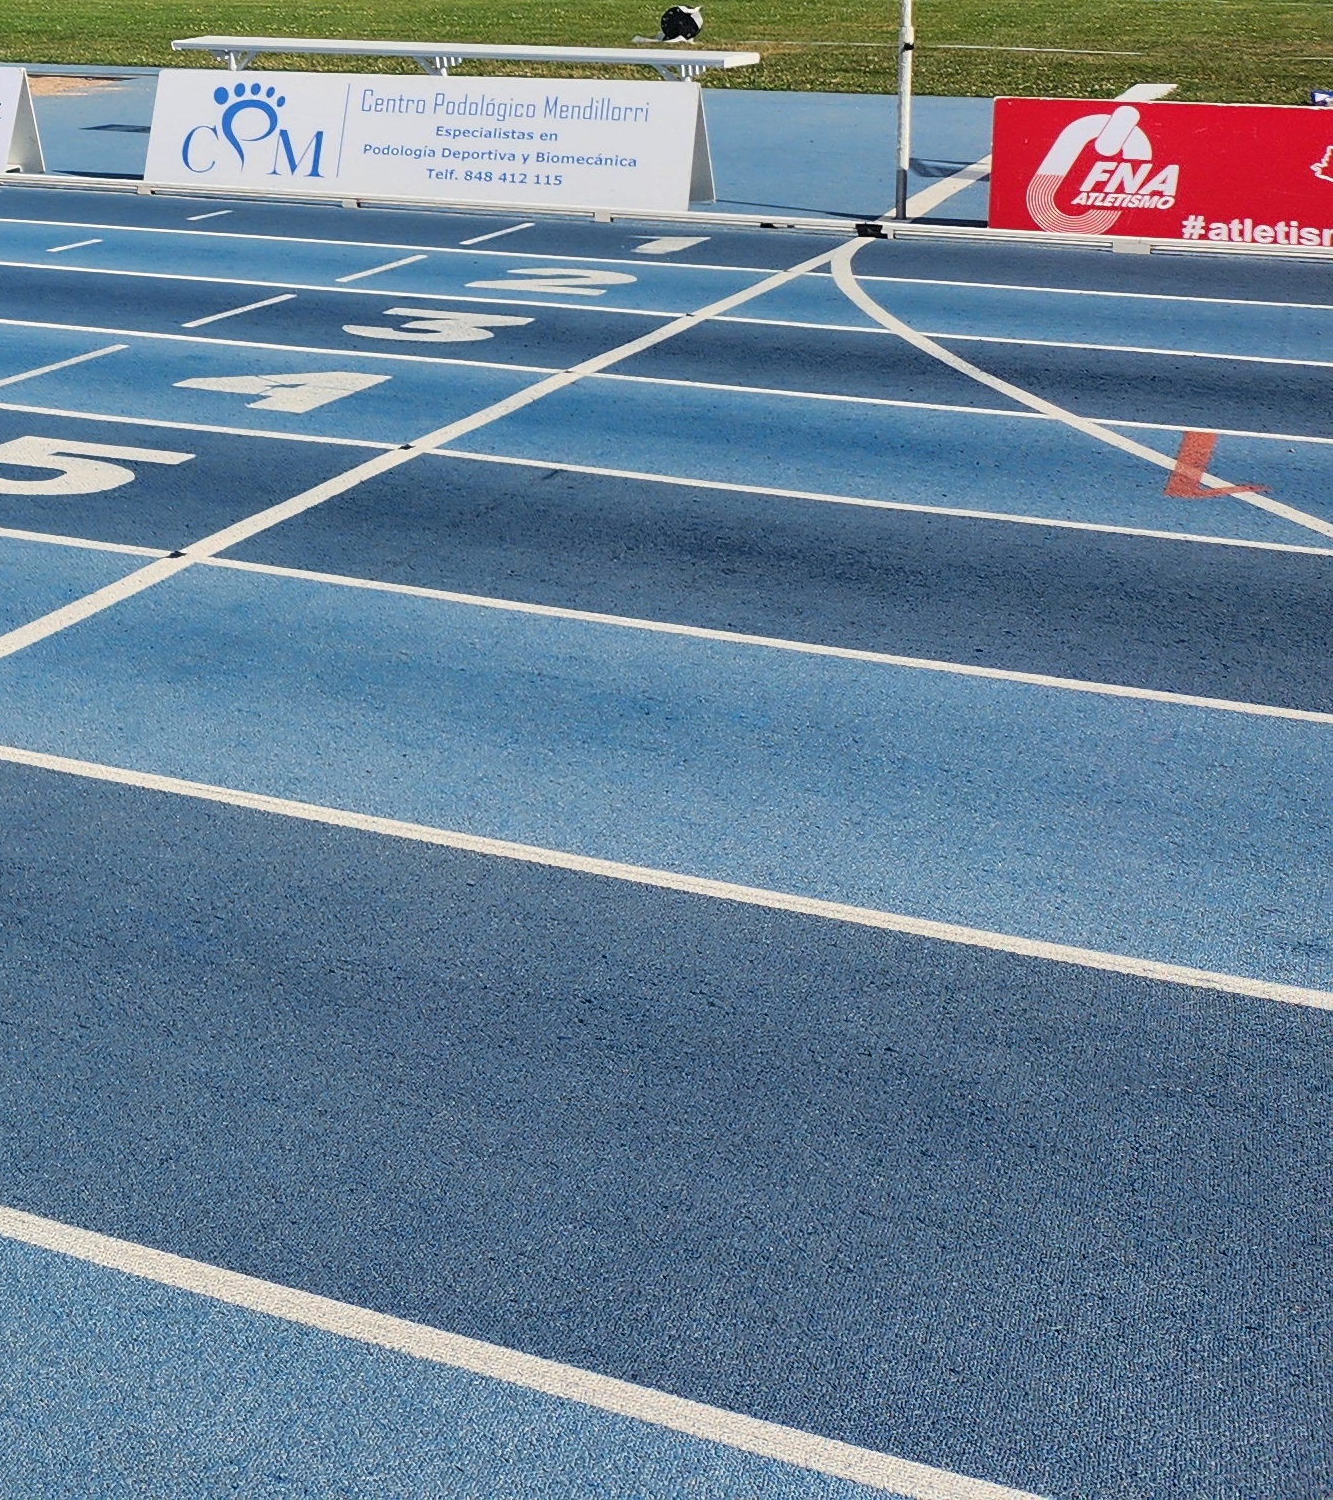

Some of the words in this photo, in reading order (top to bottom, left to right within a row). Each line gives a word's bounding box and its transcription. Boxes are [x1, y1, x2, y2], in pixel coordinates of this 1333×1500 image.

[362, 89, 426, 114] Centro
[433, 93, 536, 121] Podológico
[544, 96, 650, 122] Mendillorri
[436, 126, 534, 140] Especialistas
[539, 132, 558, 142] en
[363, 144, 436, 159] Podología
[442, 147, 516, 161] Deportiva
[521, 153, 530, 164] y
[536, 152, 637, 167] Biomecánica
[427, 168, 458, 180] Telf.
[464, 170, 493, 182] 848
[498, 172, 528, 184] 412
[533, 174, 563, 185] 115
[1080, 161, 1180, 196] FNA
[1071, 192, 1176, 209] ATLETISMO
[464, 267, 638, 296] 2
[341, 307, 536, 342] 3
[173, 370, 392, 413] 4
